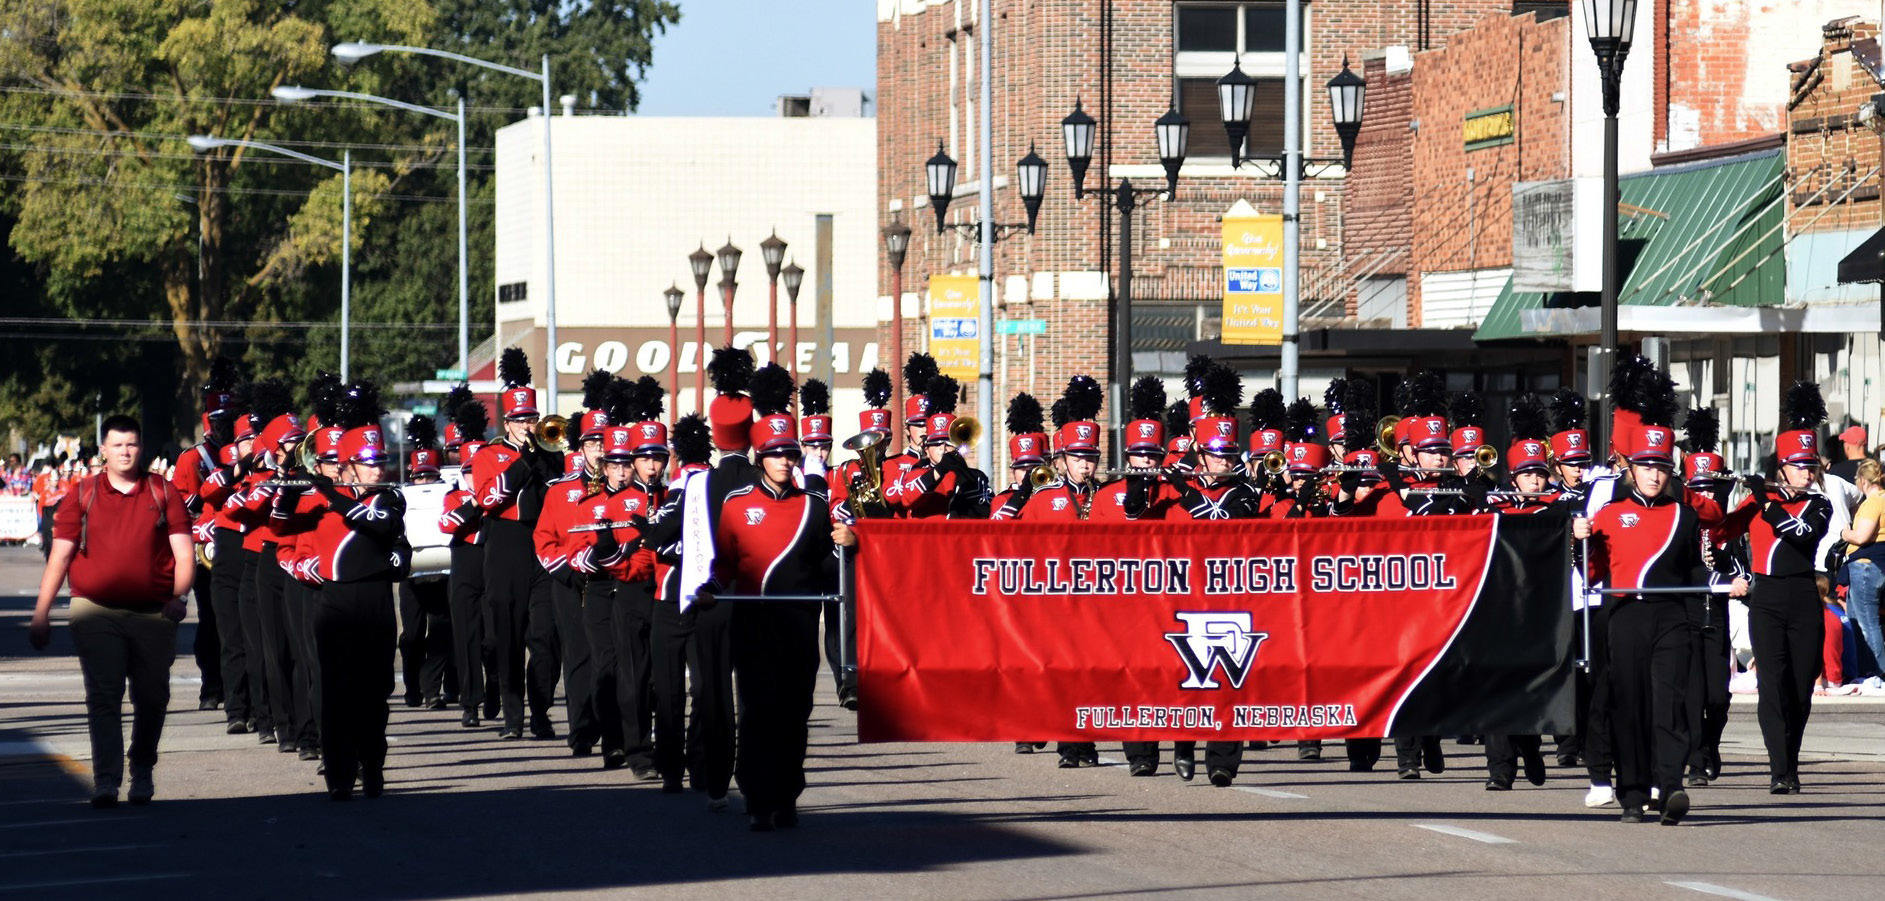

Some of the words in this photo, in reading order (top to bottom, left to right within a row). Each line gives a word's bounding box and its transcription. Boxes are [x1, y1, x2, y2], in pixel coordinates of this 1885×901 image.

[1228, 270, 1258, 281] United
[1240, 280, 1258, 291] Way
[972, 557, 1191, 595] FULLERTON
[1205, 556, 1297, 594] HIGH
[1311, 553, 1457, 592] SCHOOL
[1076, 705, 1222, 731] FULLERTON,
[1232, 704, 1358, 728] NEBRASKA
